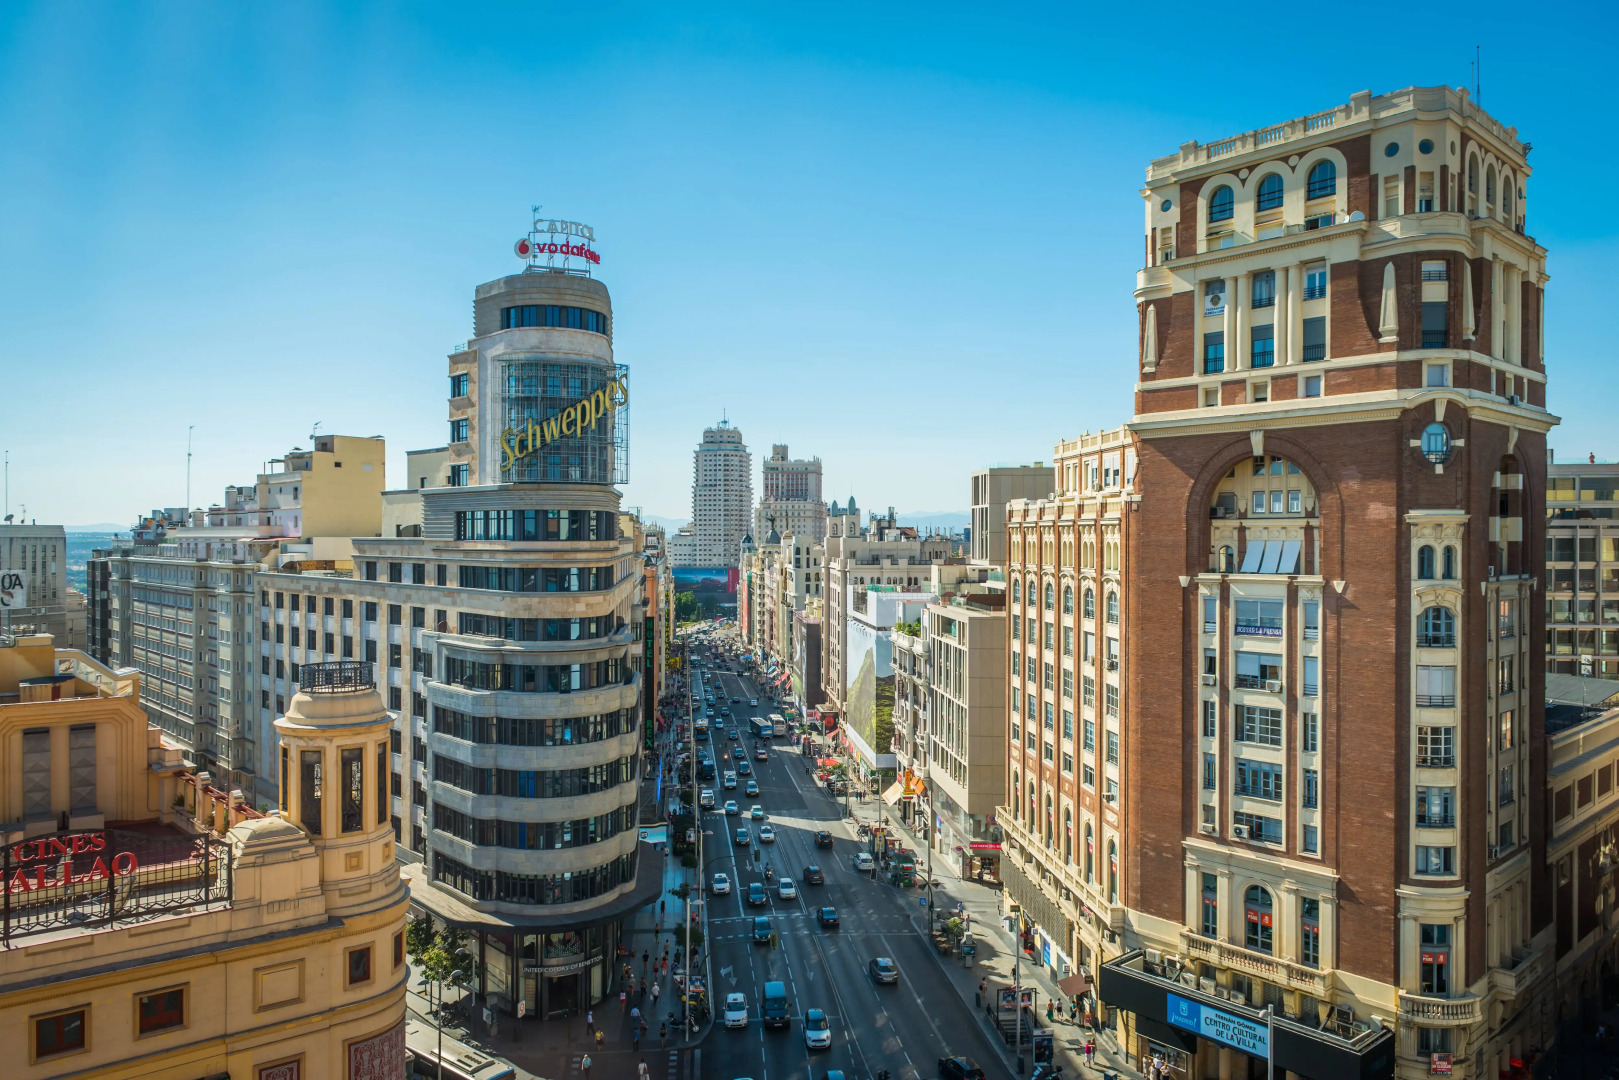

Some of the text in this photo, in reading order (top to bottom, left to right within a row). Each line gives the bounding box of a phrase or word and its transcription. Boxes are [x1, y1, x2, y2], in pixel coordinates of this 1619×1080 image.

[535, 219, 596, 242] CAPITOL
[536, 240, 600, 265] vodafone
[500, 374, 628, 471] Schweppes
[645, 719, 653, 748] REX
[13, 831, 107, 862] CINES
[0, 851, 138, 894] ALLAO
[1204, 1016, 1267, 1045] CENTRO CULTURAL
[1215, 1028, 1257, 1051] DE LA VILLA
